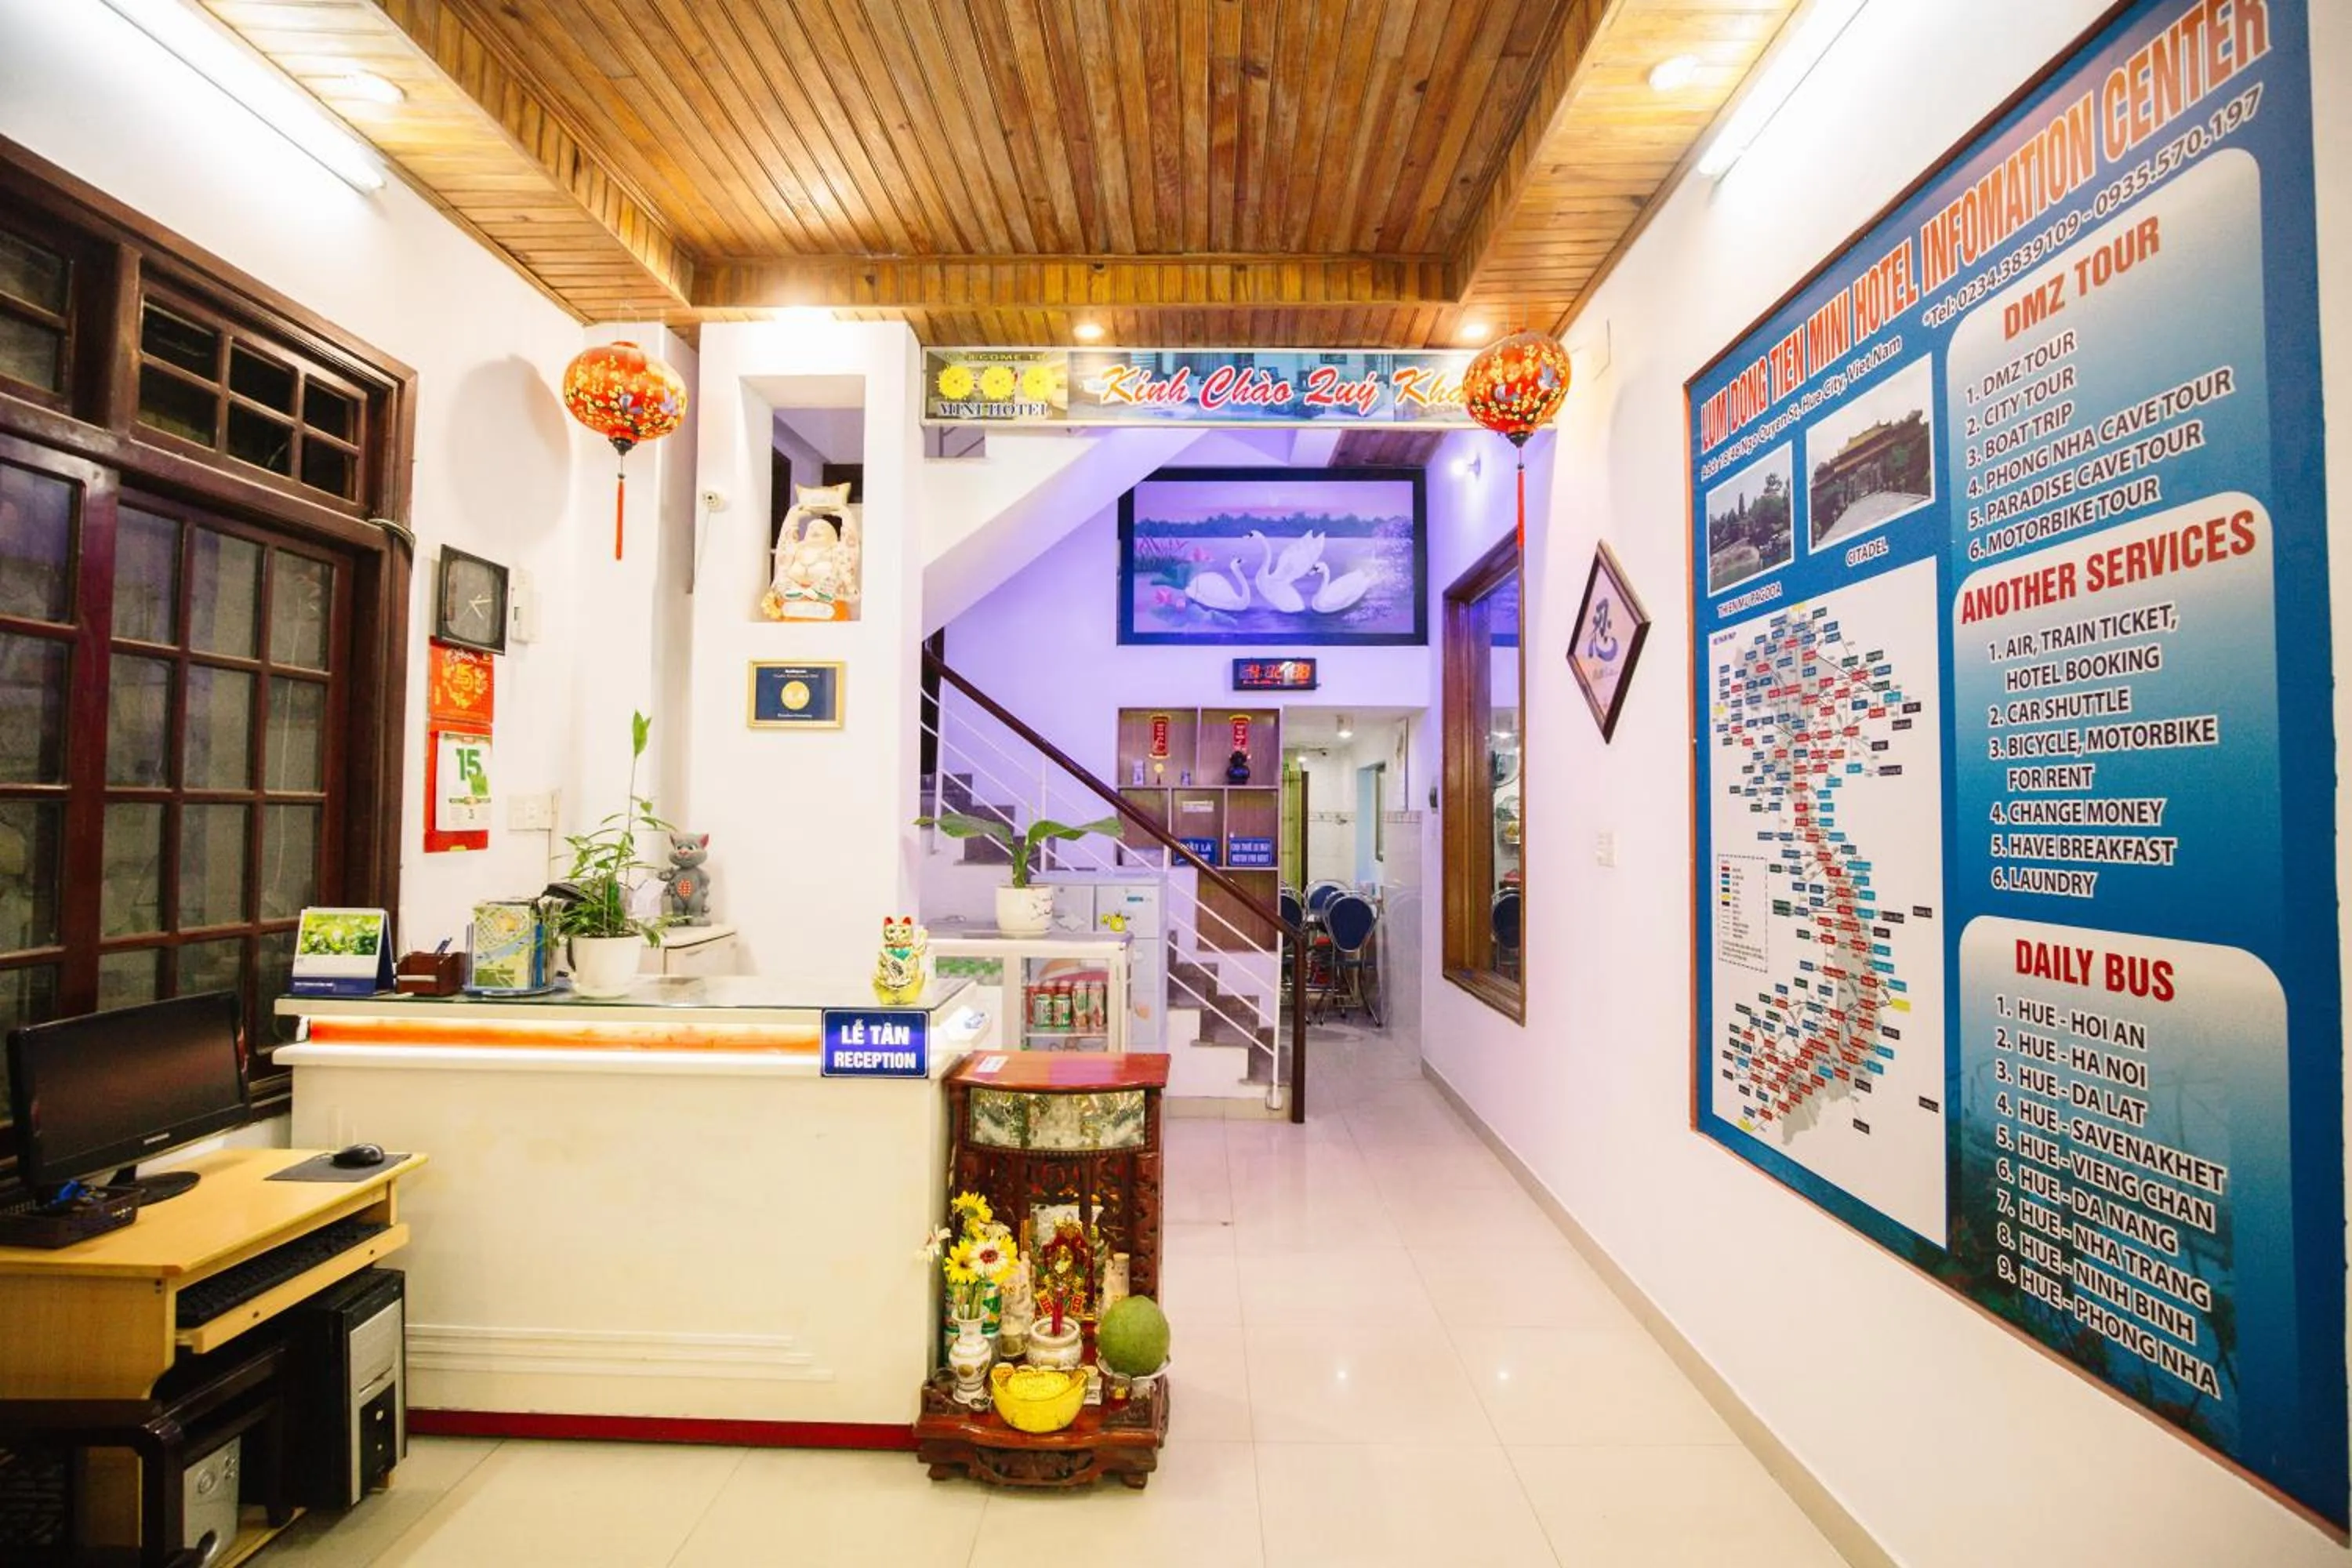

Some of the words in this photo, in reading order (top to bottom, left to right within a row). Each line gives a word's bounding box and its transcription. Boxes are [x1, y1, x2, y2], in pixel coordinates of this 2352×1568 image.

[1730, 357, 1768, 432] DONG
[1769, 322, 1806, 404] TIEN
[1808, 281, 1851, 376] MINI
[1853, 234, 1918, 344] HOTEL
[1920, 91, 2096, 292] INFOMATION
[2103, 0, 2272, 163] CENTER
[1956, 213, 2080, 311] 0234.3839109
[2094, 82, 2264, 217] 0935.570.197
[2004, 274, 2066, 341] DMZ
[2074, 216, 2160, 296] TOUR
[1872, 336, 1903, 365] Nam
[1984, 360, 2022, 396] DMZ
[2024, 331, 2077, 372] TOUR
[939, 403, 981, 416] MINI
[989, 403, 1049, 416] HOTEL
[1098, 365, 1190, 406] Kính
[1199, 365, 1294, 412] Chào
[1305, 367, 1377, 415] Quý
[1984, 395, 2022, 426] CITY
[2024, 366, 2076, 408] TOUR
[1985, 423, 2031, 459] BOAT
[2032, 402, 2073, 438] TRIP
[1986, 451, 2049, 491] PHONG
[2052, 429, 2096, 465] NHA
[2100, 399, 2158, 444] CAVE
[2161, 366, 2234, 416] TOUR
[1987, 474, 2073, 524] PARADISE
[2078, 451, 2134, 489] CAVE
[2136, 420, 2205, 466] TOUR
[1987, 499, 2096, 557] MOTORBIKE
[2097, 477, 2161, 524] TOUR
[1846, 536, 1889, 567] CITADEL
[1962, 562, 2076, 624] ANOTHER
[2086, 510, 2256, 593] SERVICES
[2005, 633, 2038, 659] AIR,
[2041, 622, 2096, 655] TRAIN
[2100, 603, 2178, 641] TICKET,
[2006, 665, 2062, 691] HOTEL
[2065, 645, 2161, 681] BOOKING
[2007, 701, 2042, 724] CAR
[2044, 688, 2129, 720] SHUTTLE
[2008, 729, 2084, 758] BICYCLE,
[2086, 717, 2217, 752] MOTORBIKE
[2008, 768, 2044, 790] FOR
[2045, 765, 2094, 789] RENT
[2009, 801, 2084, 825] CHANGE
[2085, 799, 2165, 826] MONEY
[2009, 837, 2057, 858] HAVE
[2058, 837, 2176, 865] BREAKFAST
[2009, 869, 2096, 898] LAUNDRY
[2016, 938, 2094, 987] DAILY
[2104, 951, 2176, 1003] BUS
[869, 1022, 910, 1045] TÂN
[2018, 998, 2057, 1029] HUE
[2070, 1010, 2111, 1041] HOI
[2111, 1021, 2147, 1051] AN
[834, 1051, 916, 1069] RECEPTION
[2018, 1032, 2057, 1065] HUE
[2071, 1045, 2103, 1076] HA
[2105, 1056, 2148, 1091] NOI
[2019, 1065, 2058, 1099] HUE
[2071, 1080, 2104, 1112] DA
[2105, 1091, 2147, 1127] LAT
[2019, 1100, 2059, 1134] HUE
[2070, 1116, 2227, 1196] SAVENAKHET
[2019, 1134, 2059, 1170] HUE
[2071, 1150, 2140, 1201] VIENG
[2141, 1182, 2216, 1234] CHAN
[2020, 1167, 2060, 1204] HUE
[2073, 1186, 2107, 1222] DA
[2107, 1201, 2179, 1255] NANG
[2020, 1200, 2061, 1239] HUE
[2073, 1223, 2121, 1267] NHA
[2124, 1247, 2212, 1312] TRANG
[2020, 1233, 2061, 1275] HUE
[2074, 1259, 2132, 1312] NINH
[2135, 1291, 2197, 1345] BINH
[2020, 1268, 2062, 1312] HUE
[2075, 1298, 2158, 1363] PHONG
[2159, 1343, 2221, 1402] NHA
